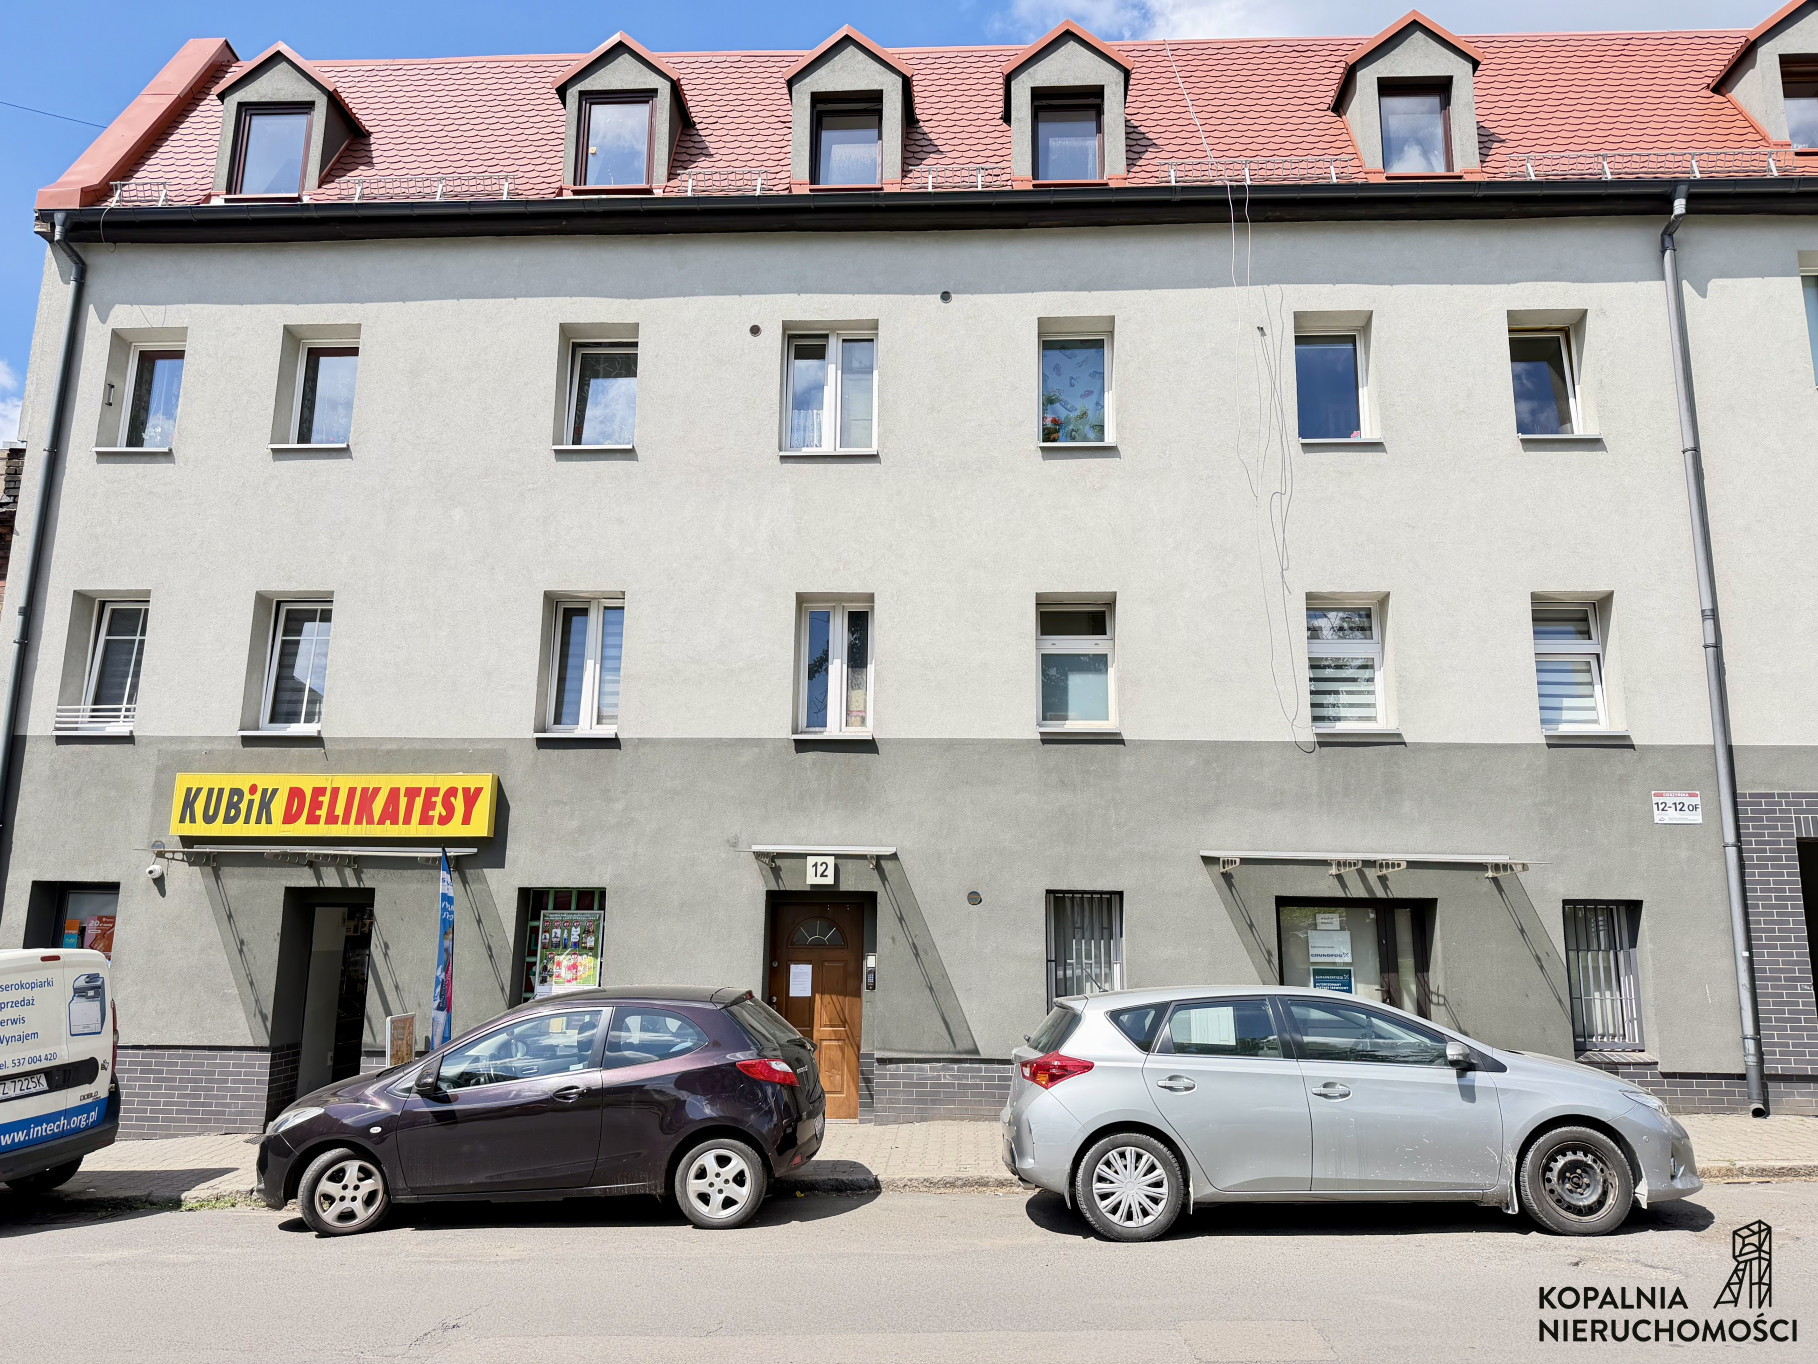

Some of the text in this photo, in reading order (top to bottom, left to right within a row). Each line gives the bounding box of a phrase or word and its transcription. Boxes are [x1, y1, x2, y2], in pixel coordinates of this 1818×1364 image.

[282, 786, 484, 826] DELIKATESY
[1654, 801, 1700, 812] 12-12 OF
[811, 861, 829, 878] 12
[0, 977, 54, 992] serokopiarki
[0, 996, 35, 1012] przedaż
[0, 1015, 26, 1027] erwis
[0, 1052, 58, 1070] el. 537 004 420
[0, 1082, 8, 1096] Z
[11, 1075, 45, 1093] 7225K
[0, 1106, 99, 1146] ww.intech.org.pl
